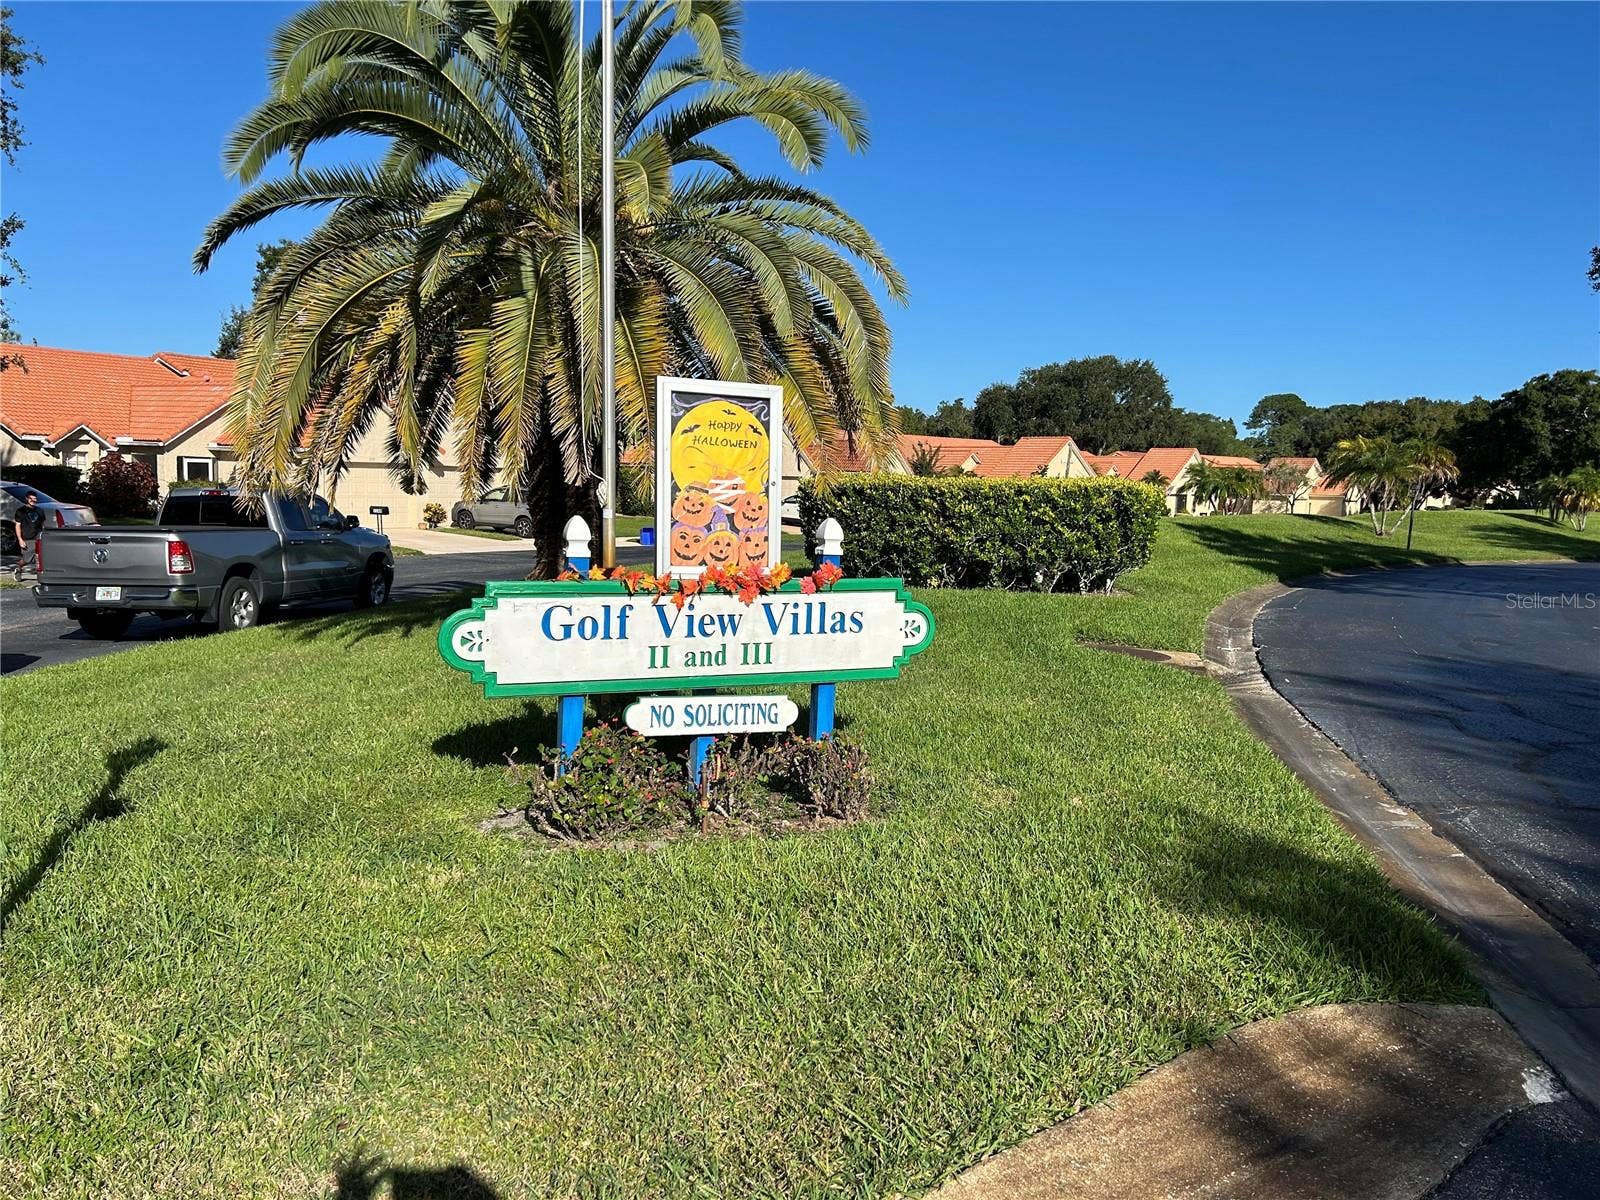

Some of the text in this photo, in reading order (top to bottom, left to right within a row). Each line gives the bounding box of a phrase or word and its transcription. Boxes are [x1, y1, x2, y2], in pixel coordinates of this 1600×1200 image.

[709, 420, 742, 432] Happy
[692, 435, 758, 449] HALLOWEEN
[540, 601, 865, 642] Golf View Villas
[647, 642, 774, 669] II and III
[649, 702, 779, 728] NO SOLICITING
